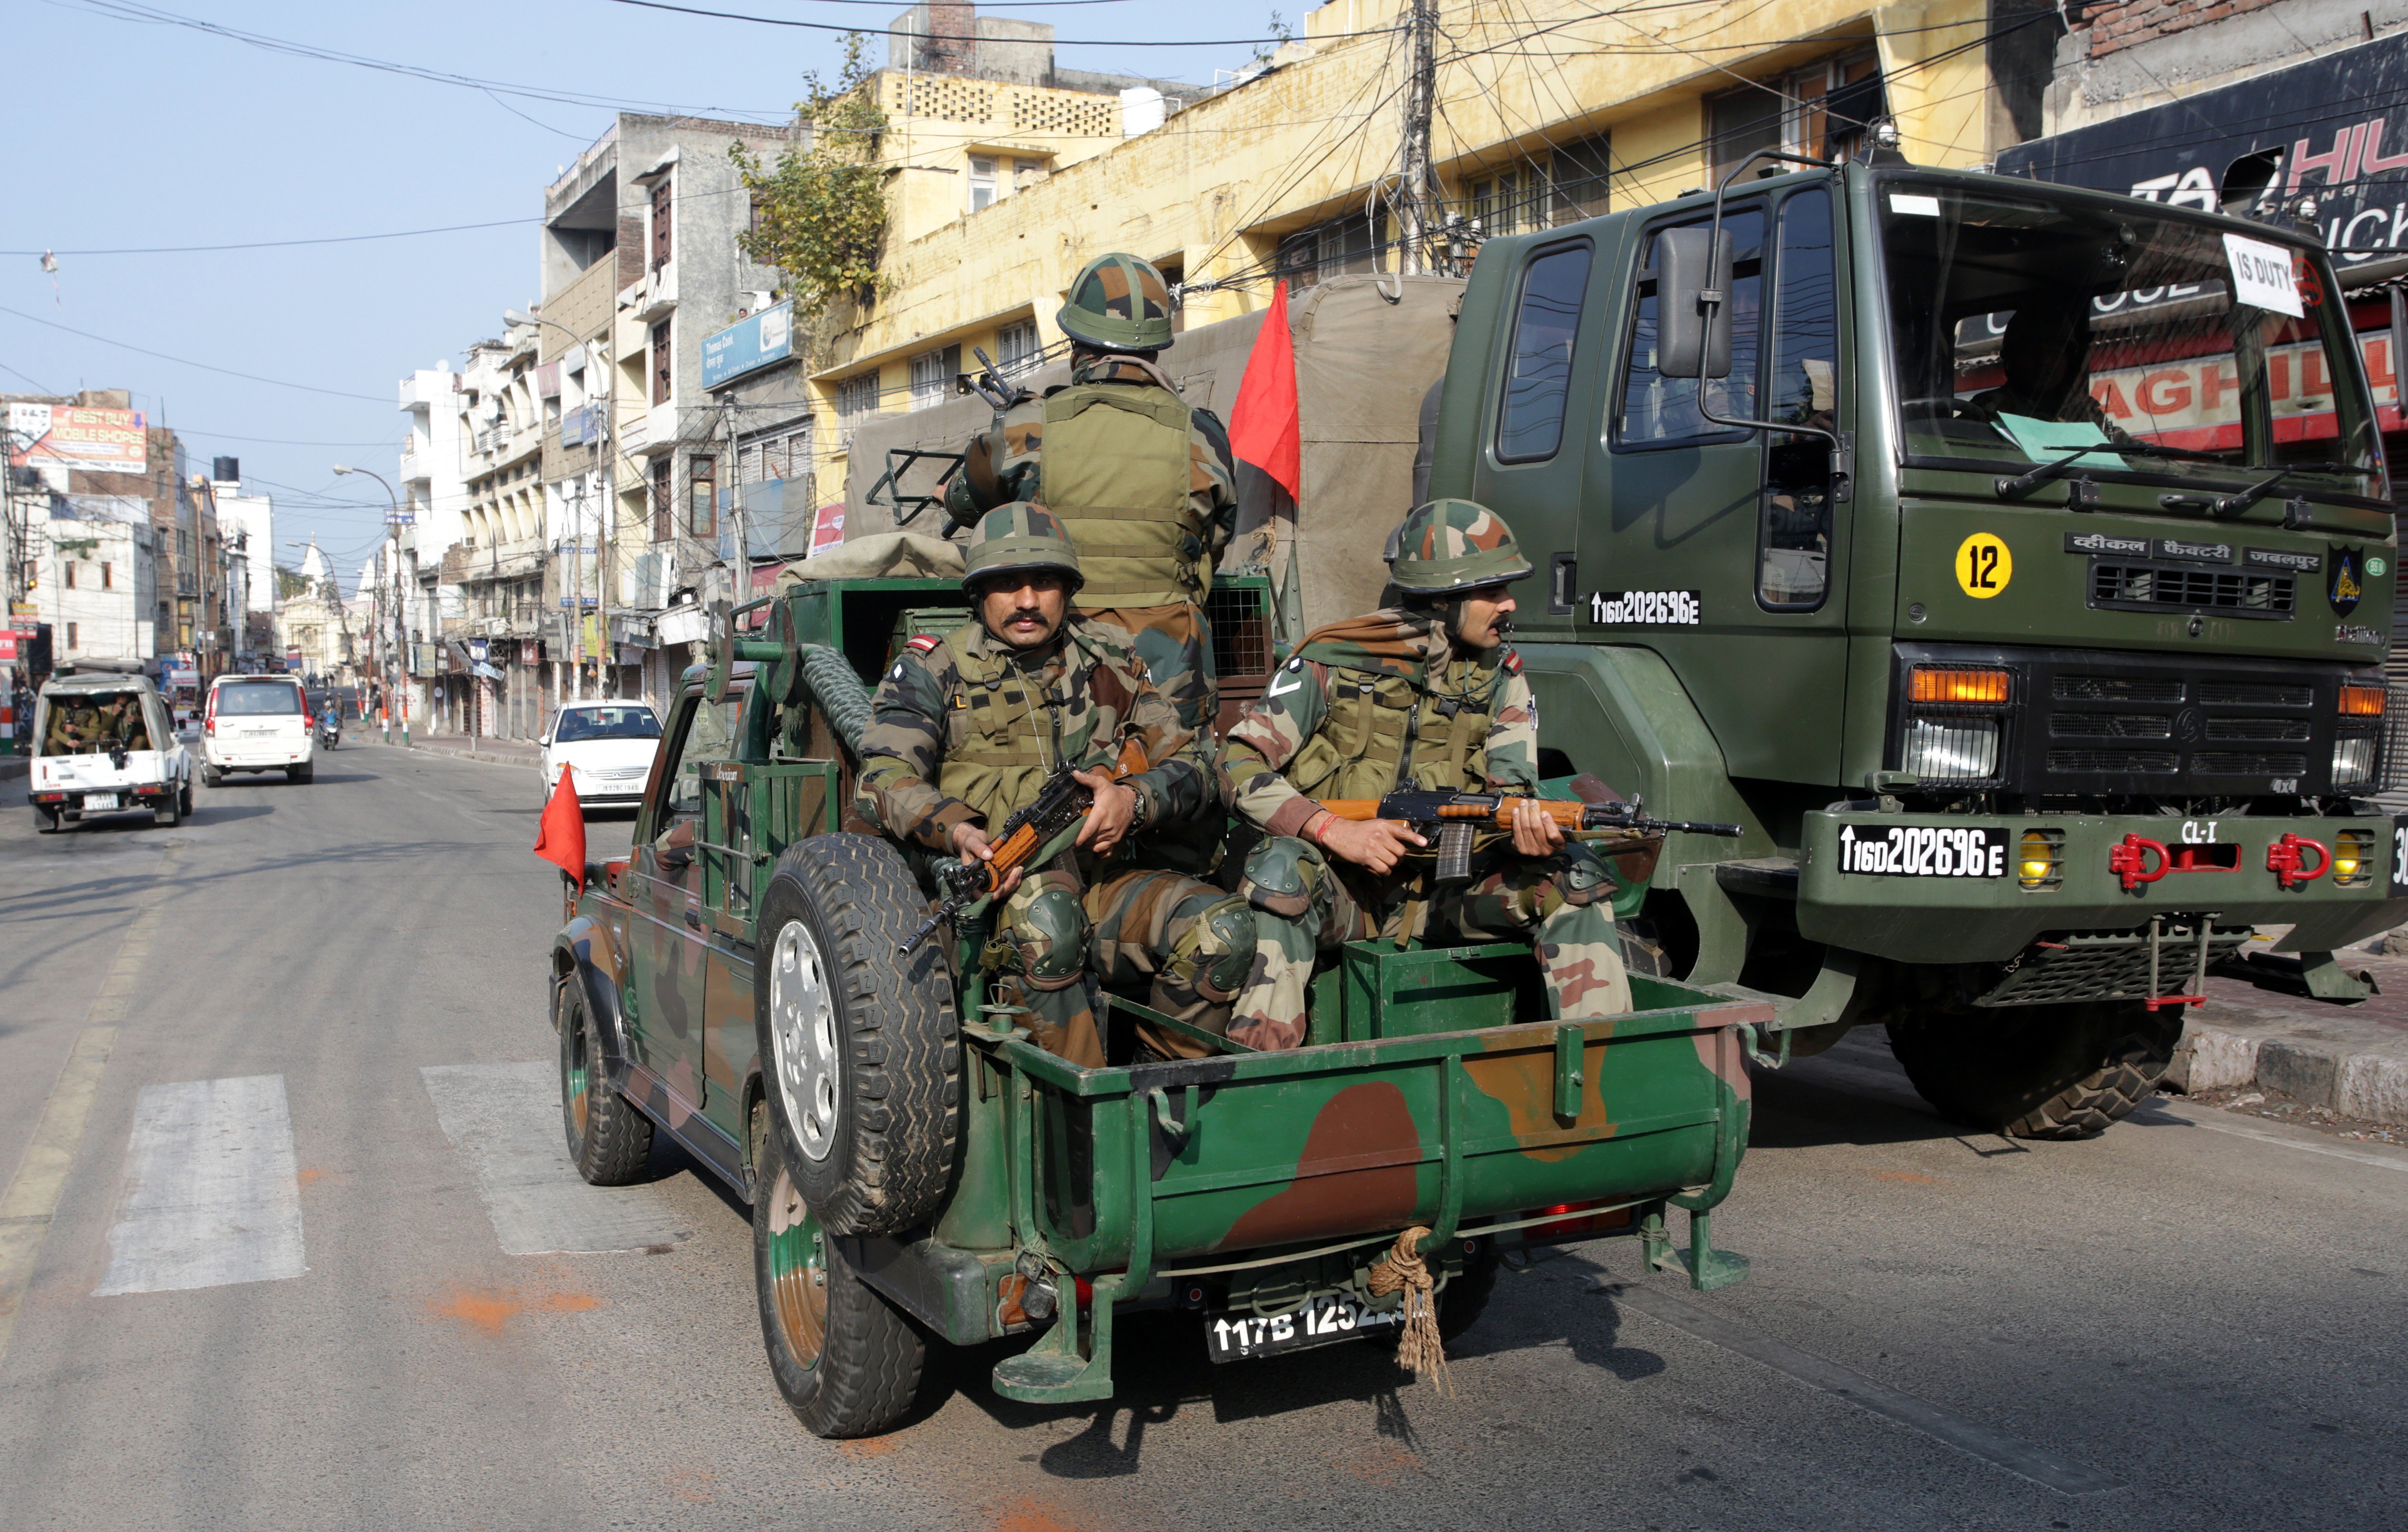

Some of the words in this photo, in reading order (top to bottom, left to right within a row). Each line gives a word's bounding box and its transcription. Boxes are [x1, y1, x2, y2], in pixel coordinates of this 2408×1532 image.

[2236, 252, 2253, 282] IS
[2254, 256, 2291, 292] DUTY
[706, 340, 722, 355] Thomas
[722, 333, 734, 349] Cook
[72, 410, 104, 424] BEST
[105, 412, 131, 426] BUY
[52, 427, 97, 442] MOBILE
[97, 429, 144, 445] SHOPEE
[1970, 545, 1998, 589] 12
[2074, 534, 2147, 552] व्हीकल
[2164, 540, 2230, 559] फैक्टरी
[2250, 551, 2319, 568] जबलपुर
[2271, 778, 2297, 793] 4x4
[2393, 827, 2408, 885] 3
[1232, 1313, 1295, 1347] 17B
